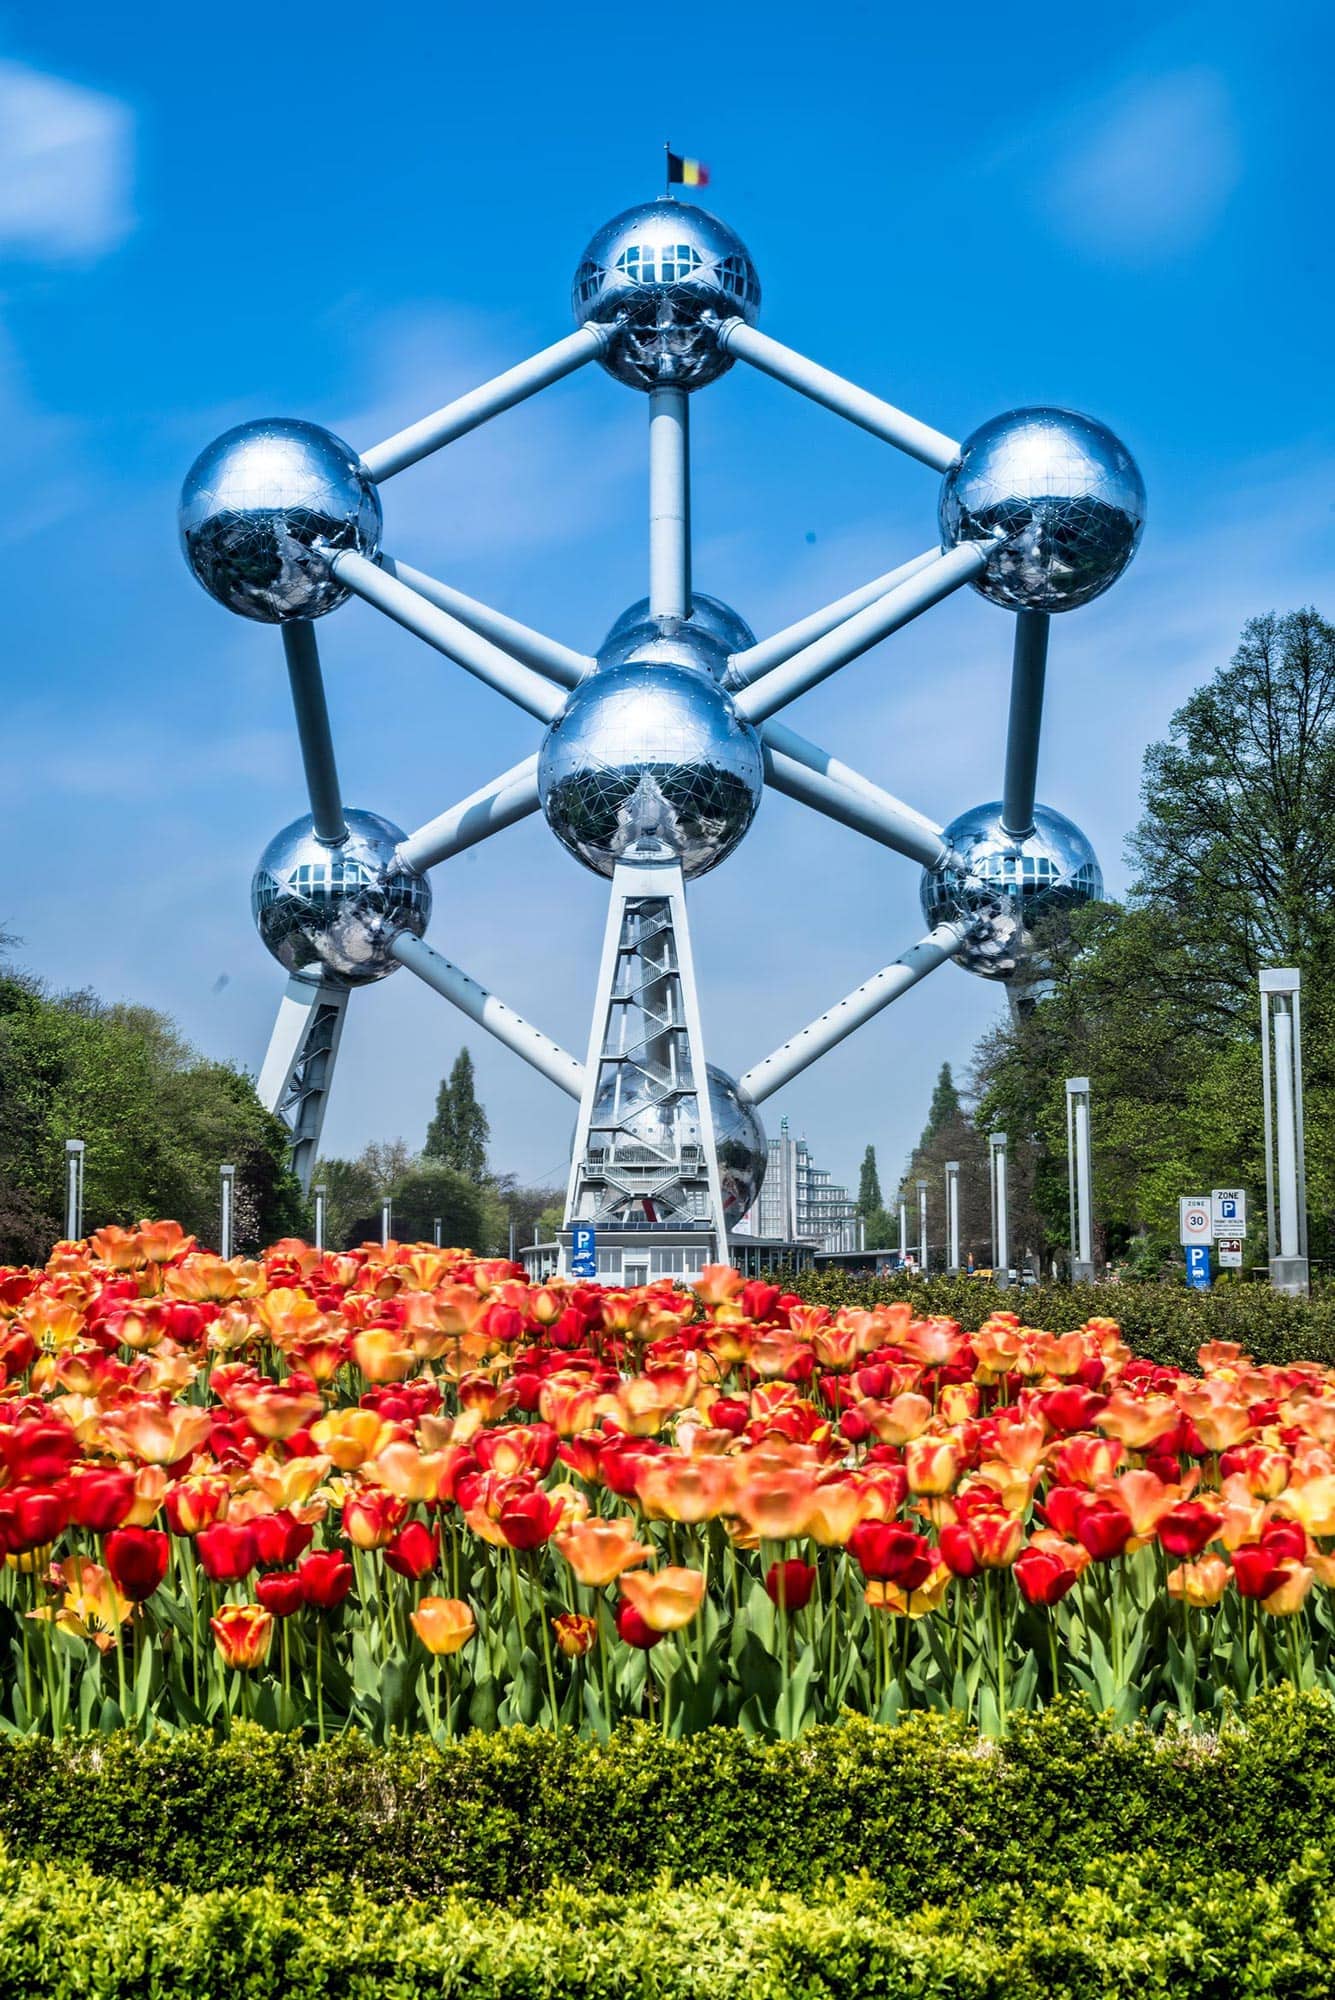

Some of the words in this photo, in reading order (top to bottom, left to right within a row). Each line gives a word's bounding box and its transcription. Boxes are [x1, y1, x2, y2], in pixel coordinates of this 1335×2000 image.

[1223, 1202, 1233, 1216] P
[1190, 1216, 1204, 1226] 30
[578, 1231, 590, 1248] P
[1191, 1248, 1204, 1266] P
